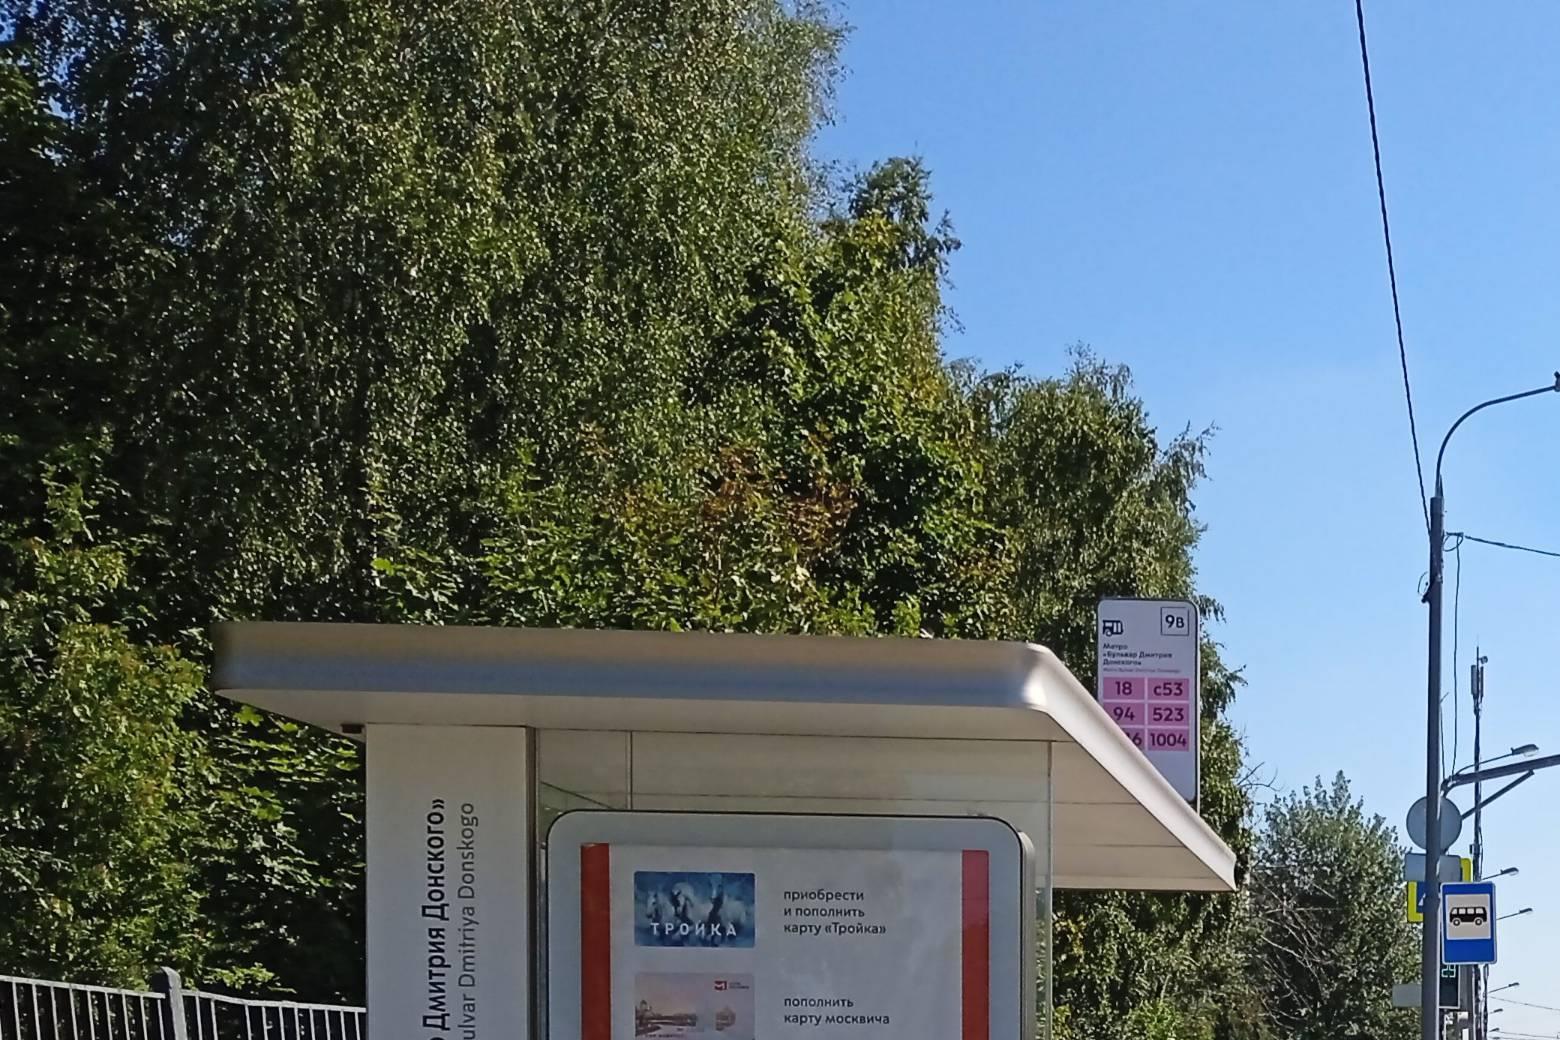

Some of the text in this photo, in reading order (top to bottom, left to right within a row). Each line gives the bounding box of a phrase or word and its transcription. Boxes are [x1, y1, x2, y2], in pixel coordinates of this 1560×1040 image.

[1115, 681, 1133, 696] 18
[1113, 706, 1185, 722] 94 523
[1150, 732, 1187, 747] 1004
[456, 802, 479, 898] Donskogo
[421, 797, 450, 921] Донского»
[783, 889, 864, 903] приобрести
[783, 907, 865, 918] и пополнить
[650, 920, 738, 937] ТРОЙКА
[783, 922, 887, 936] карту «Тройка»
[457, 905, 480, 987] Dmitriya
[422, 927, 452, 1031] Дмитрия
[783, 998, 855, 1008] пополнить
[783, 1015, 890, 1026] карту москвича
